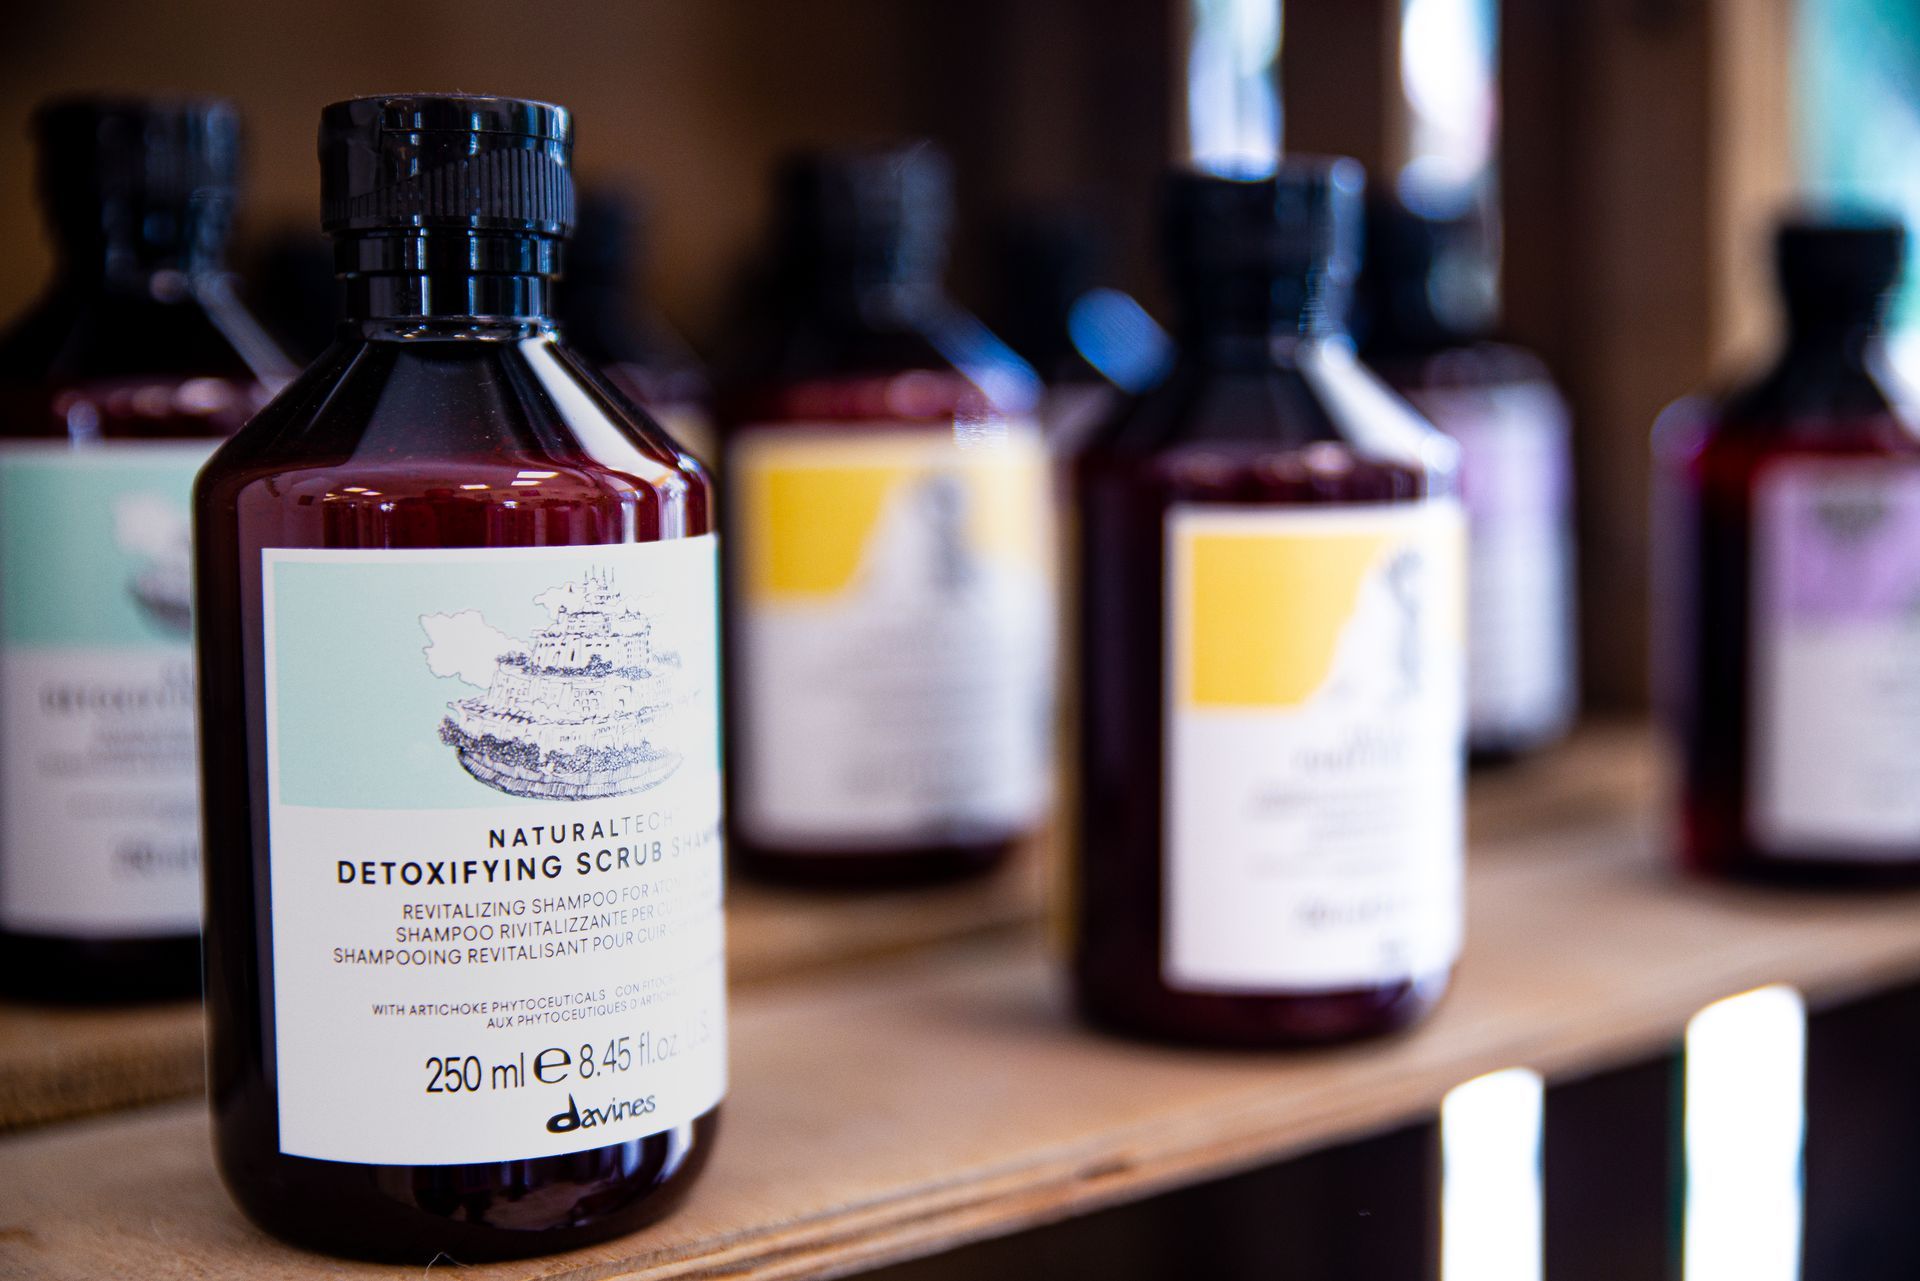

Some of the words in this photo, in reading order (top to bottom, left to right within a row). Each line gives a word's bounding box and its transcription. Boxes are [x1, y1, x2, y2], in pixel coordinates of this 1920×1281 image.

[488, 809, 673, 849] NATURALTECH
[337, 855, 563, 886] DETOXIFYING
[576, 840, 663, 876] SCRUB
[402, 899, 526, 921] REVITALIZING
[531, 889, 618, 914] SHAMPOO
[622, 883, 649, 902] FOR
[395, 924, 494, 943] SHAMPOO
[500, 909, 628, 940] RIVITALIZZANTE
[631, 904, 655, 922] PER
[333, 947, 462, 966] SHAMPOOING
[468, 938, 589, 965] REVITALISANT
[593, 932, 634, 953] POUR
[638, 924, 667, 944] CUIR
[372, 1003, 405, 1017] WITH
[409, 1001, 488, 1017] ARTICHOKE
[492, 988, 606, 1013] PHYTOCEUTICALS
[615, 983, 640, 998] CON
[487, 1014, 513, 1030] AUX
[517, 1000, 627, 1027] PHYTOCEUTIQUES
[425, 1055, 482, 1094] 250
[492, 1052, 524, 1090] ml
[579, 1036, 631, 1080] 8.45
[546, 1093, 656, 1134] davines
